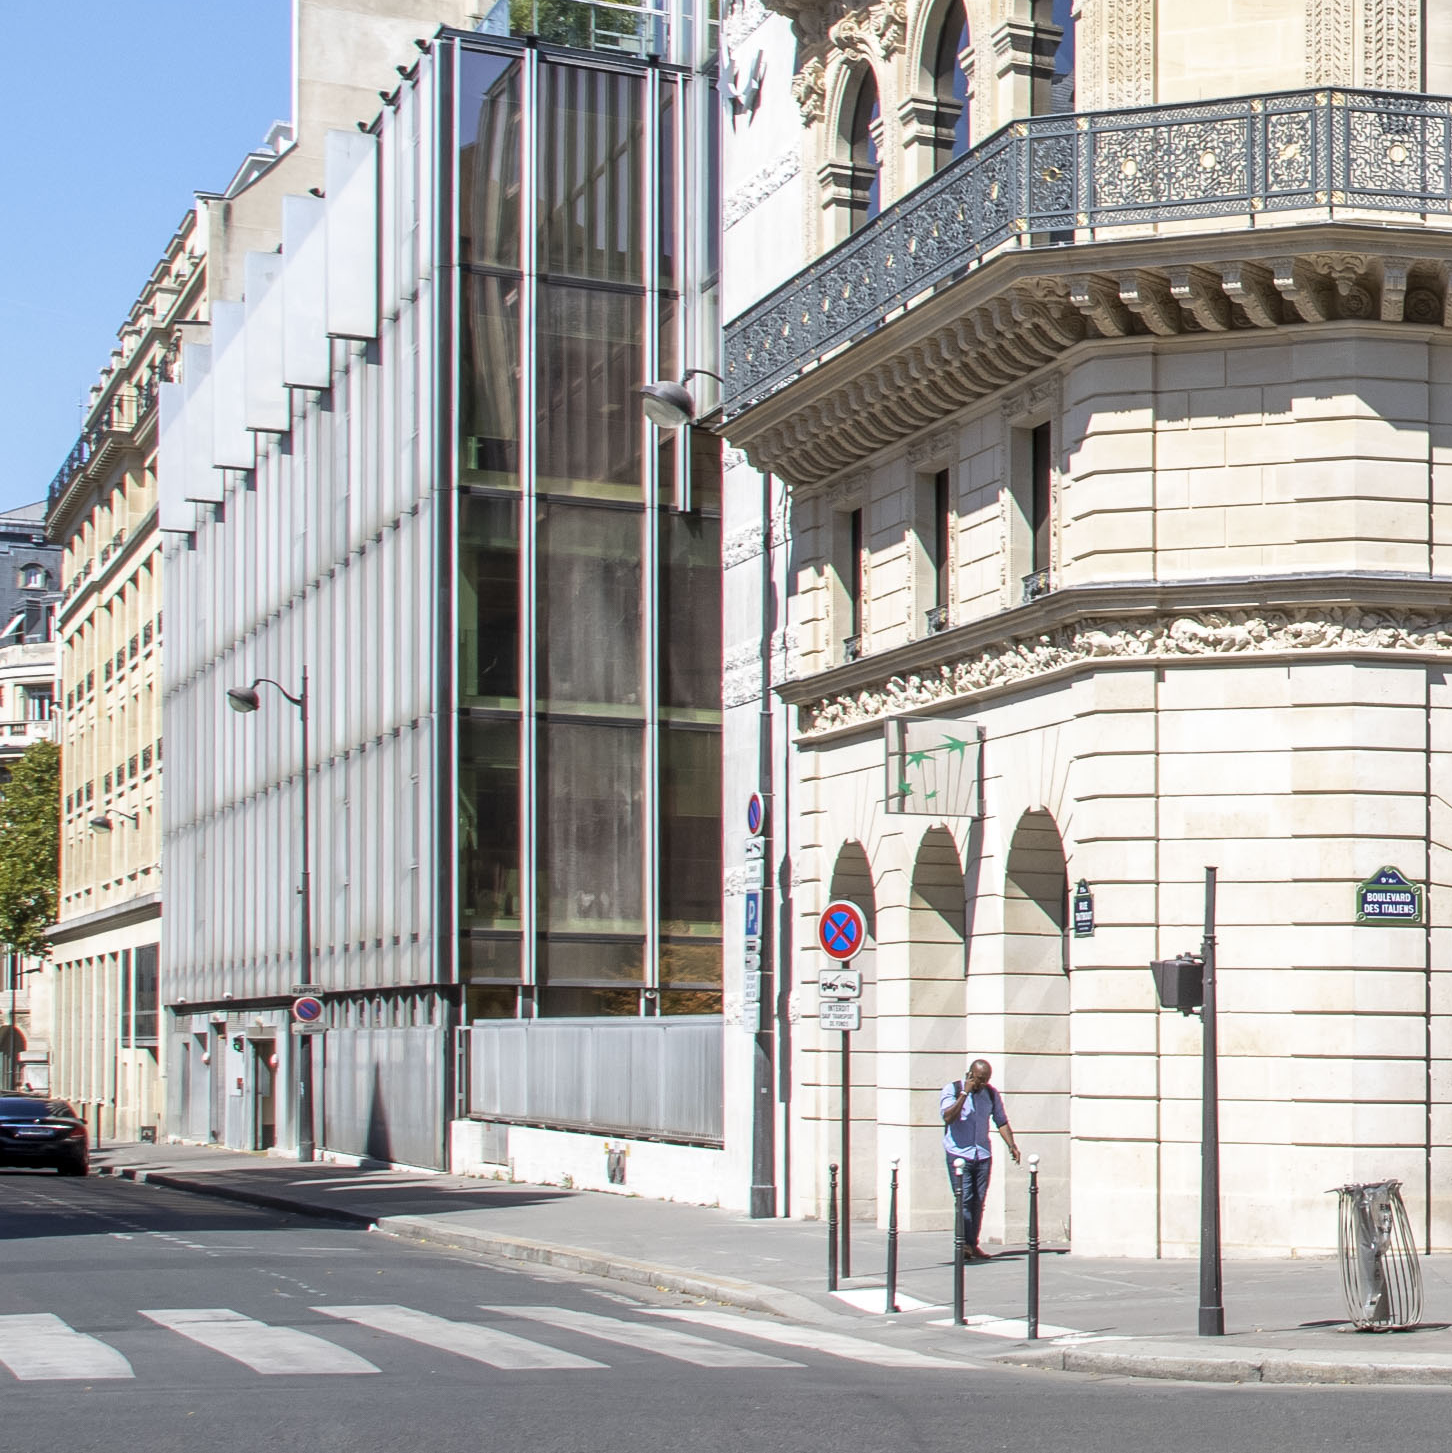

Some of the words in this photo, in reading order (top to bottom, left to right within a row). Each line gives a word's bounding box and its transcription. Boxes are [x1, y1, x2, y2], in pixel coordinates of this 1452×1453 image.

[1366, 893, 1411, 902] BOULEVARD
[1364, 904, 1379, 913] DES
[1382, 904, 1414, 913] ITALIENS
